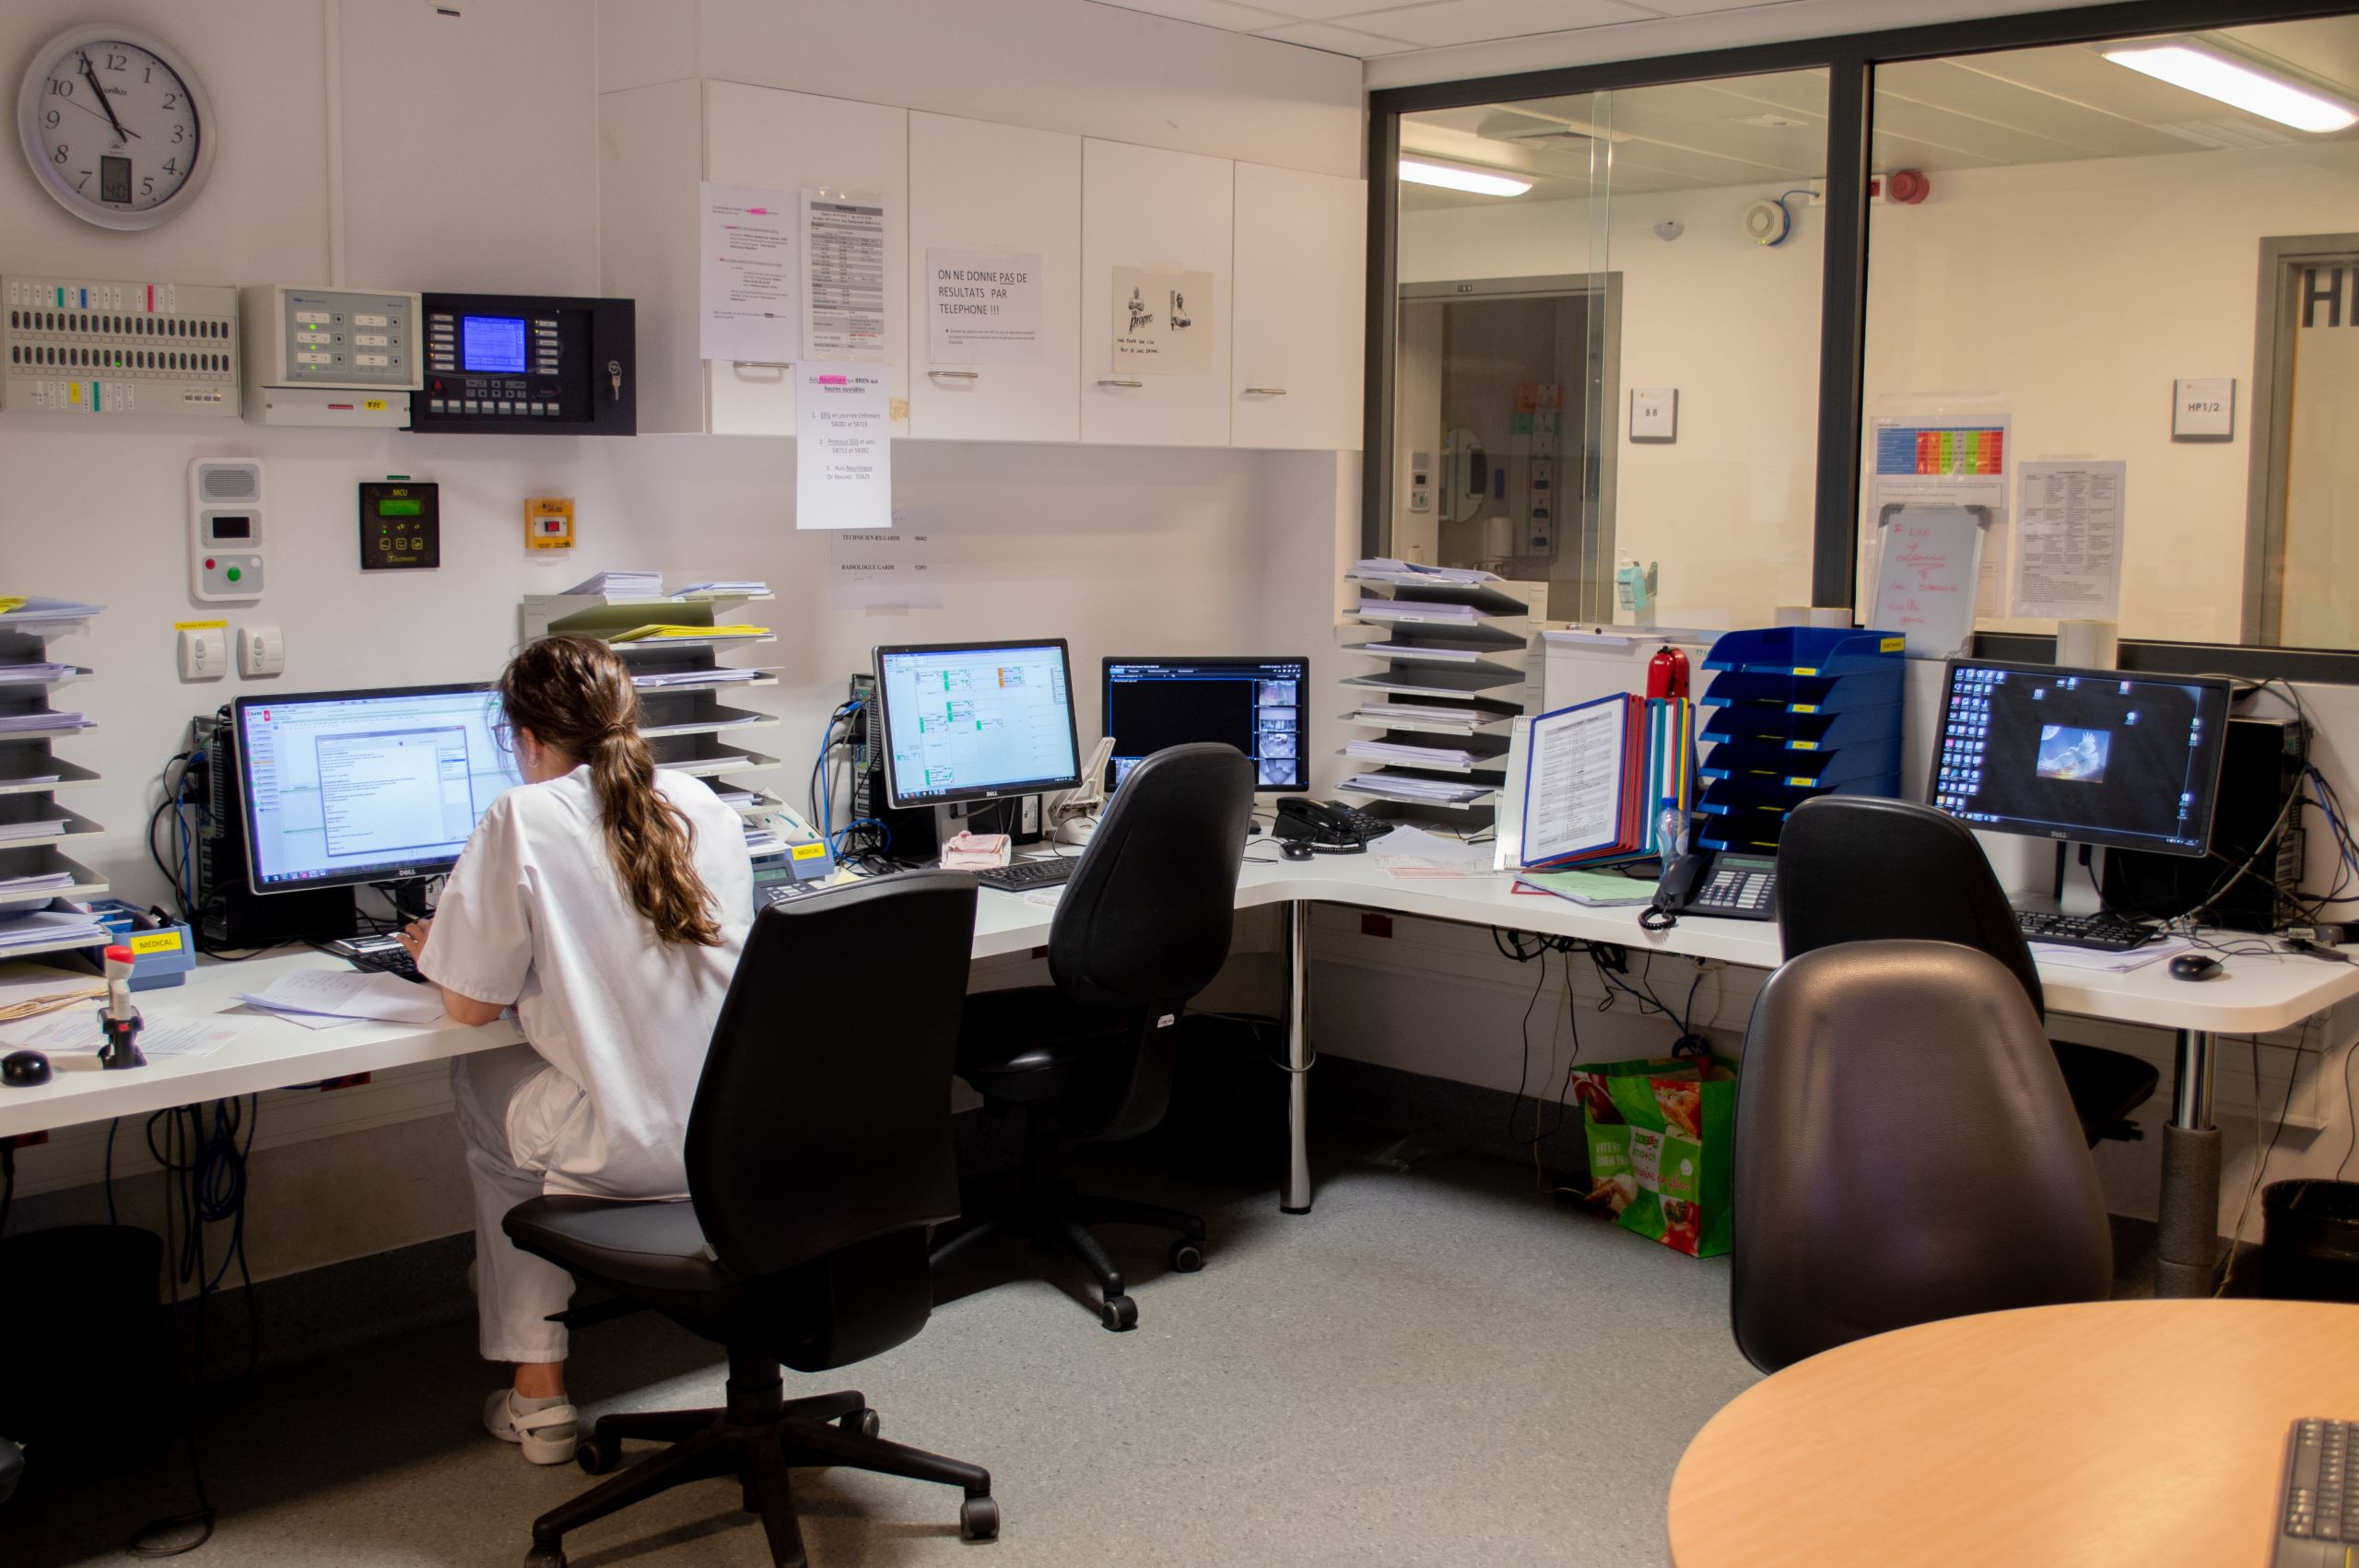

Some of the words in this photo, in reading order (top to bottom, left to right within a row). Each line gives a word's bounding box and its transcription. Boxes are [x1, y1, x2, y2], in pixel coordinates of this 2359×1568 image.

[104, 54, 127, 71] 12
[143, 67, 152, 84] 1
[50, 79, 74, 97] 10
[161, 93, 176, 110] 2
[45, 111, 61, 130] 9
[171, 125, 184, 144] 3
[54, 145, 69, 163] 8
[161, 157, 178, 175] 4
[77, 170, 93, 190] 7
[140, 177, 155, 196] 5
[938, 269, 951, 280] ON
[953, 270, 965, 281] NE
[967, 271, 998, 283] DONNE
[1000, 273, 1015, 284] PAS
[1016, 273, 1028, 284] DE
[938, 287, 985, 298] RESULTATS
[991, 288, 1008, 299] PAR
[939, 303, 988, 315] TELEPHONE
[2188, 403, 2220, 413] HP1/2
[393, 488, 408, 497] MCU
[2050, 831, 2068, 839] DELL
[139, 938, 174, 949] MÉDICAL
